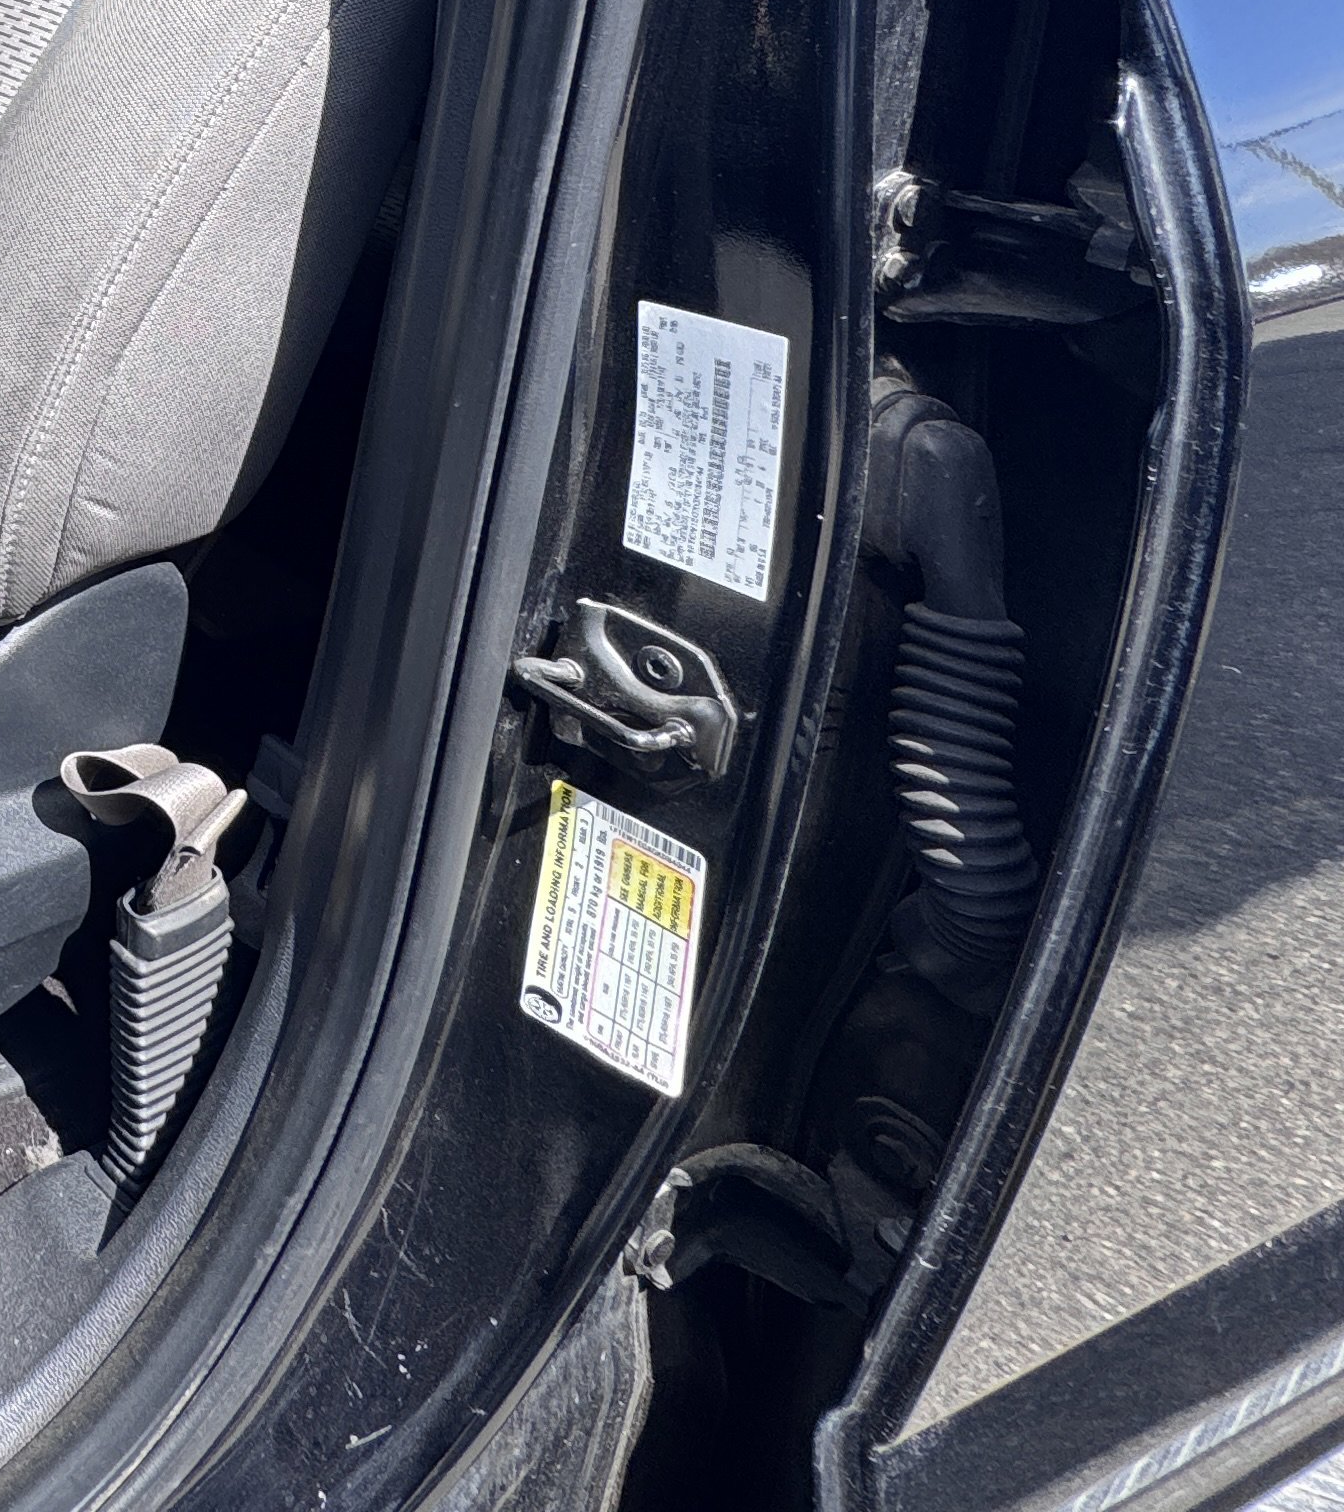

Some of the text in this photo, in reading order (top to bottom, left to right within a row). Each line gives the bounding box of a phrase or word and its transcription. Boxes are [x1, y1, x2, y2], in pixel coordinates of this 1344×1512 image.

[593, 847, 605, 873] 1919
[639, 858, 650, 878] FOR
[535, 785, 574, 979] TIRE AND LOADING INFORMATION
[592, 872, 602, 885] or
[589, 883, 602, 899] kg
[618, 885, 629, 902] SEE
[585, 896, 598, 919] 870
